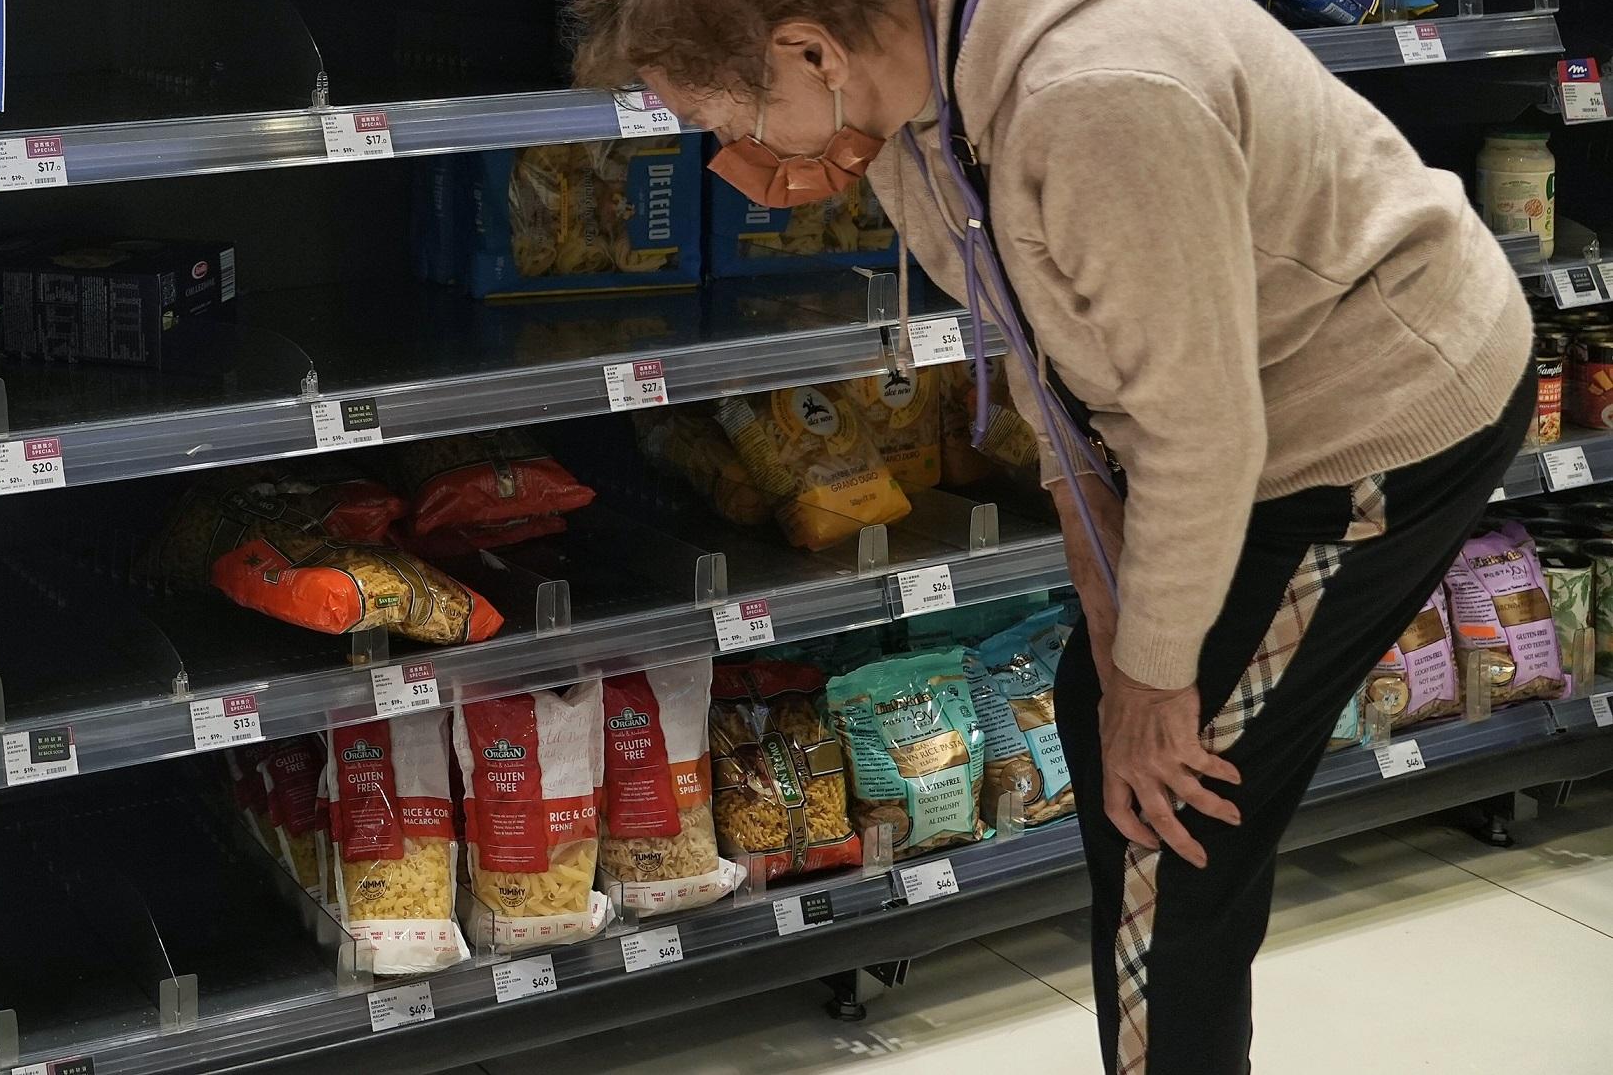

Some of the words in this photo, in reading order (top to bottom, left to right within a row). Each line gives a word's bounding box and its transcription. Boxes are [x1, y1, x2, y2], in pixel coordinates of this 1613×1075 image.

[38, 162, 61, 172] $17.0
[484, 746, 525, 760] ORGRAN
[487, 770, 525, 784] GLUTEN
[677, 772, 699, 786] RICE
[495, 778, 517, 793] FREE
[679, 783, 702, 796] SPIRALS
[919, 776, 961, 793] GLUTEN-FREE
[918, 794, 937, 805] GOOD
[937, 787, 964, 802] TEXTURE
[924, 804, 938, 815] NOT
[939, 801, 960, 813] MUSHY
[928, 816, 937, 825] AL
[937, 813, 957, 824] DENTE
[498, 886, 526, 899] TUMMY
[531, 975, 555, 989] $49.0
